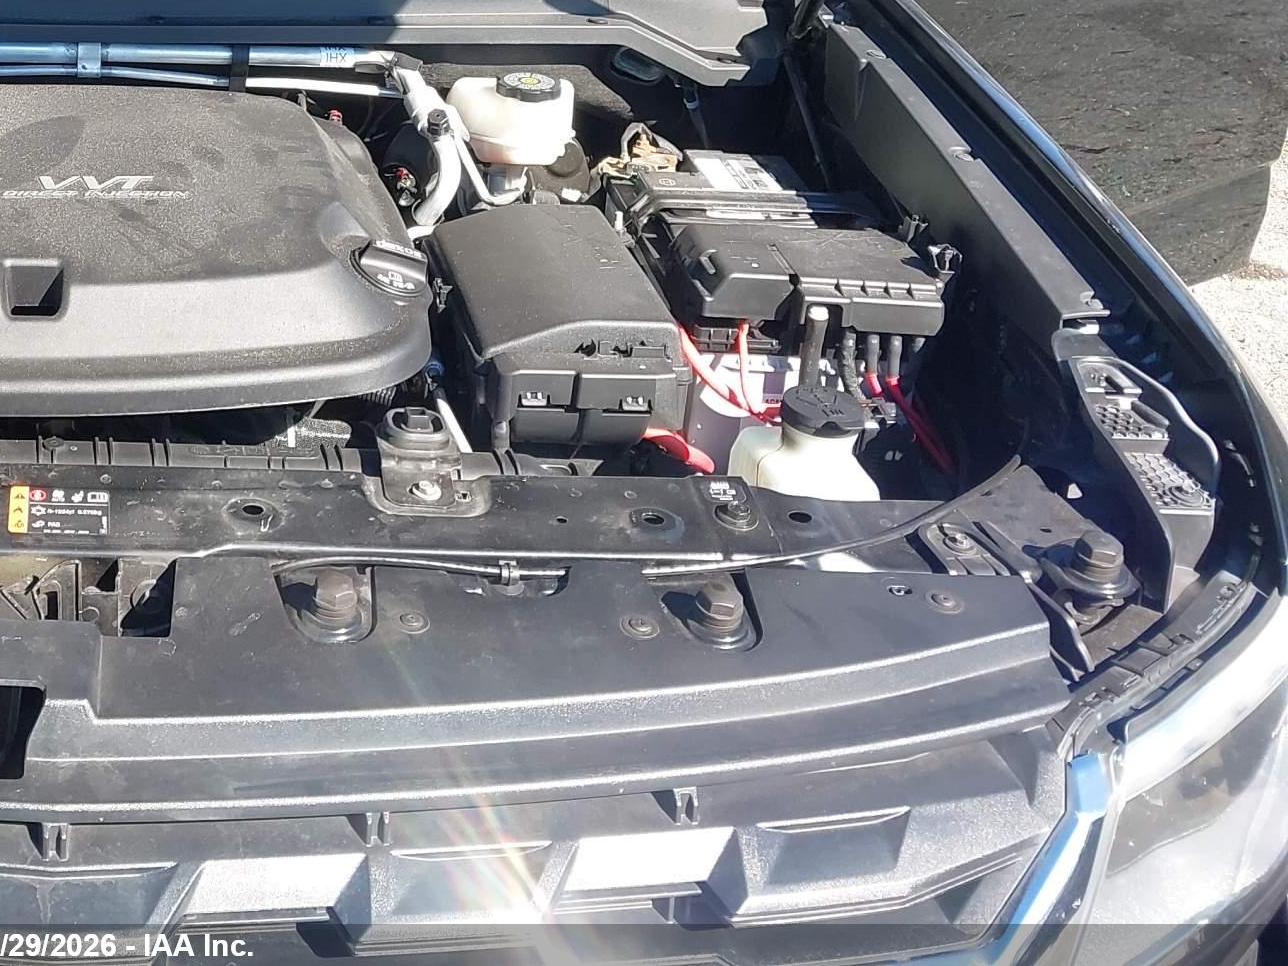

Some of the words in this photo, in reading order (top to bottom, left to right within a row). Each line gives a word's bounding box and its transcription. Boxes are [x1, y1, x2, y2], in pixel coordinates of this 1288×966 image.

[38, 175, 154, 191] VVT
[2, 190, 79, 199] DIRECT
[85, 190, 191, 199] INJECTION
